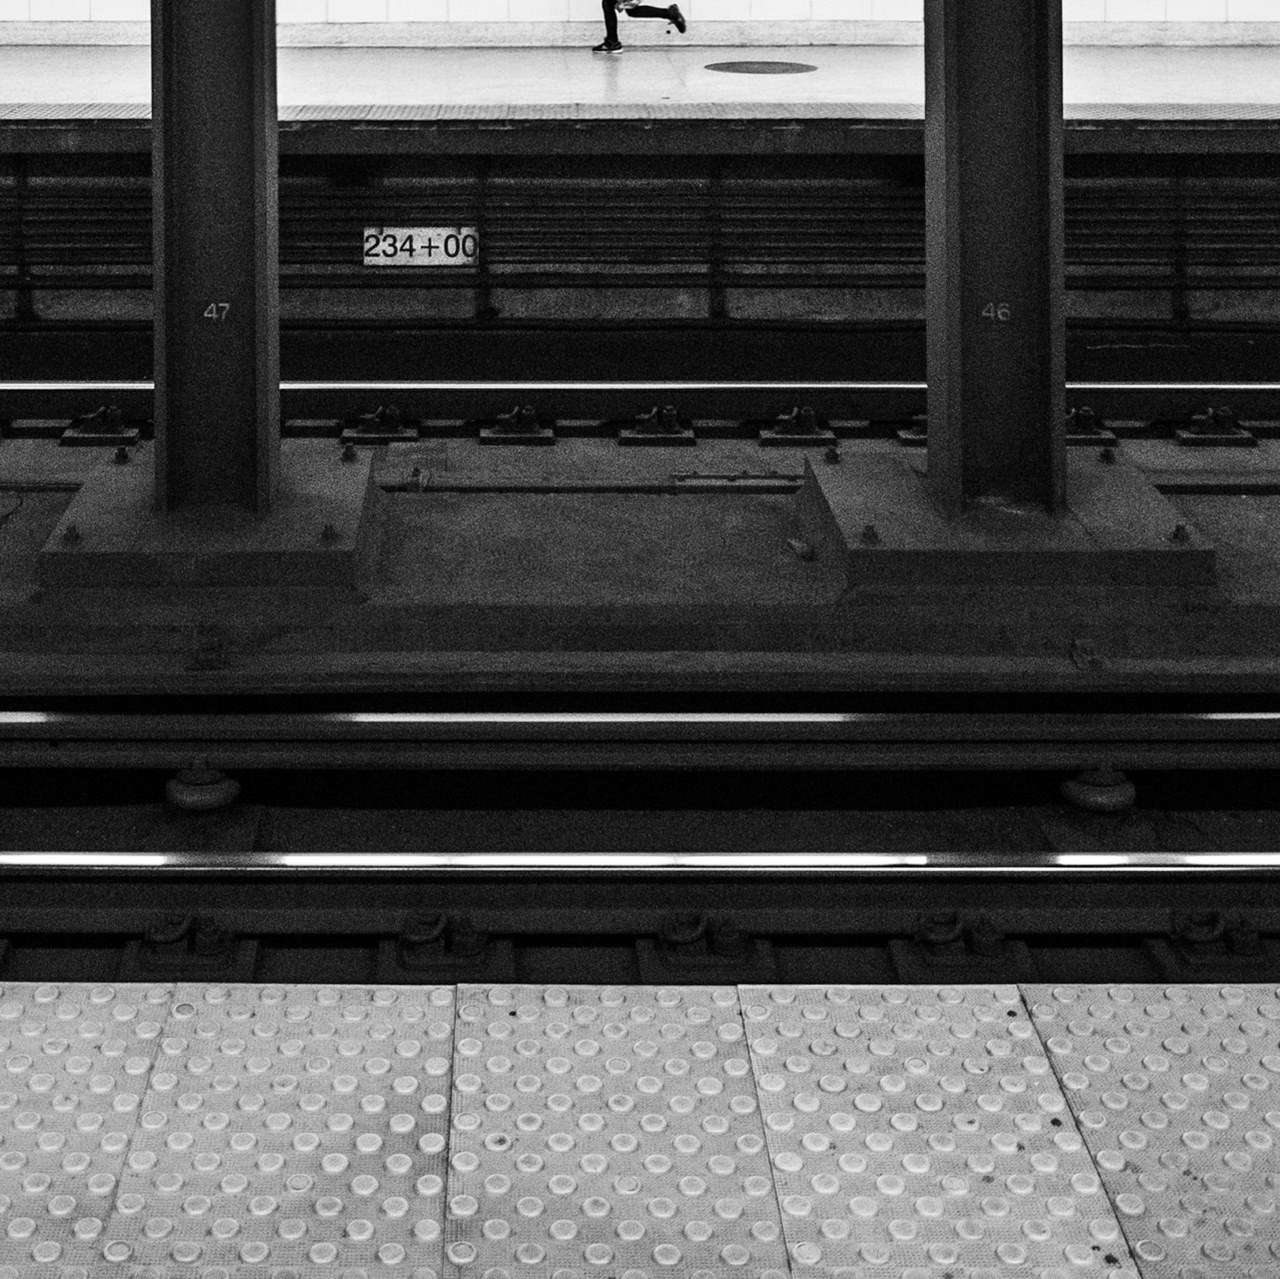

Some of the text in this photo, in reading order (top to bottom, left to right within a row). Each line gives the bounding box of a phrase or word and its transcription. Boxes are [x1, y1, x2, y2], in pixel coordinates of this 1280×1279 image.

[364, 234, 478, 258] 234+00
[203, 302, 230, 321] 47
[982, 302, 1011, 321] 46
